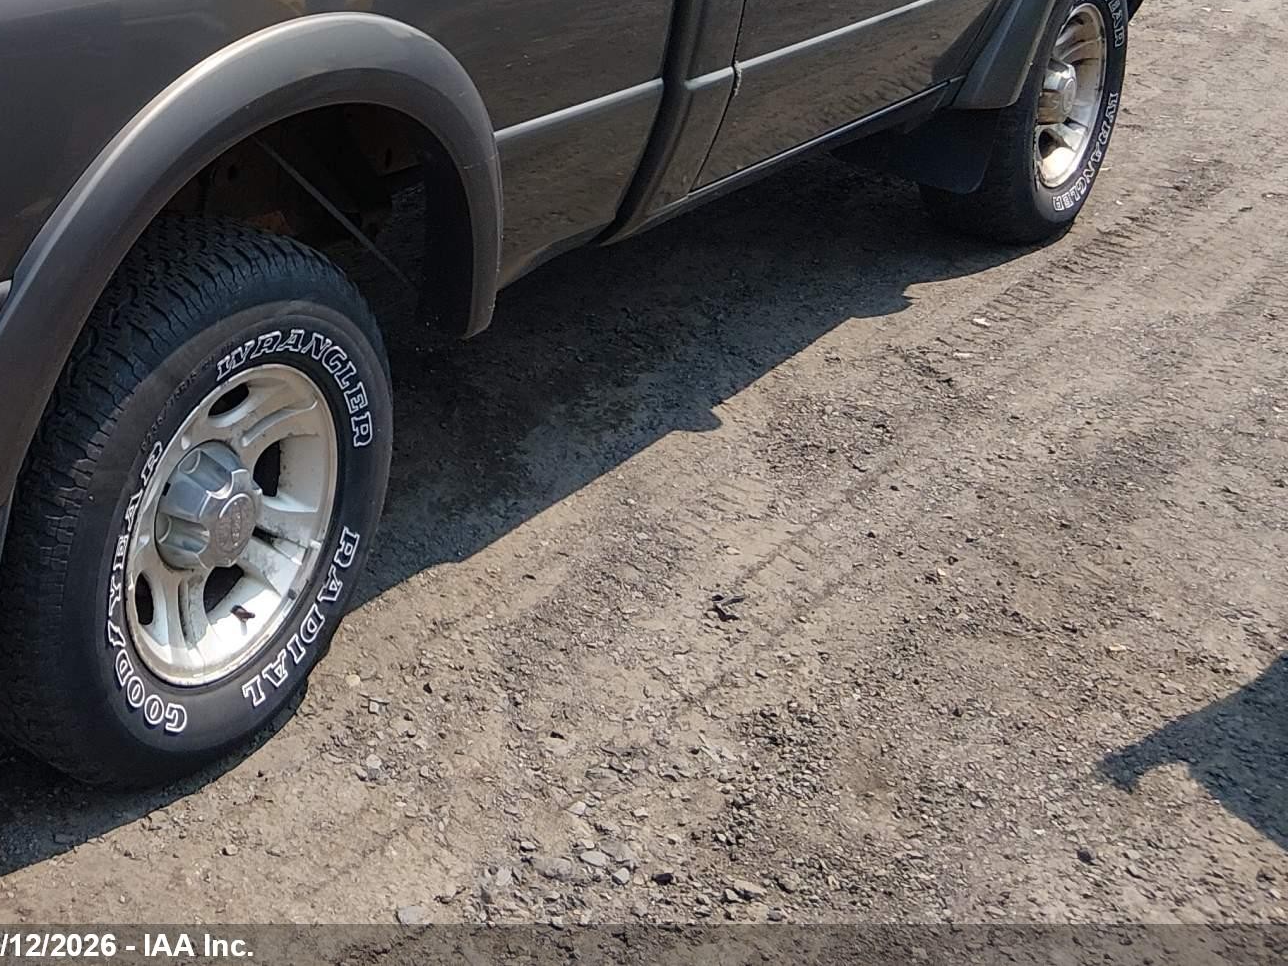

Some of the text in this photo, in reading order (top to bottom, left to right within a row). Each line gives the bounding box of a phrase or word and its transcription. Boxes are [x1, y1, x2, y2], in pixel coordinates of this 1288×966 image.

[1052, 92, 1119, 212] WRANGLER
[216, 329, 374, 448] WRANGLER
[107, 441, 187, 733] GOODYEAR
[242, 526, 361, 707] RADIAL
